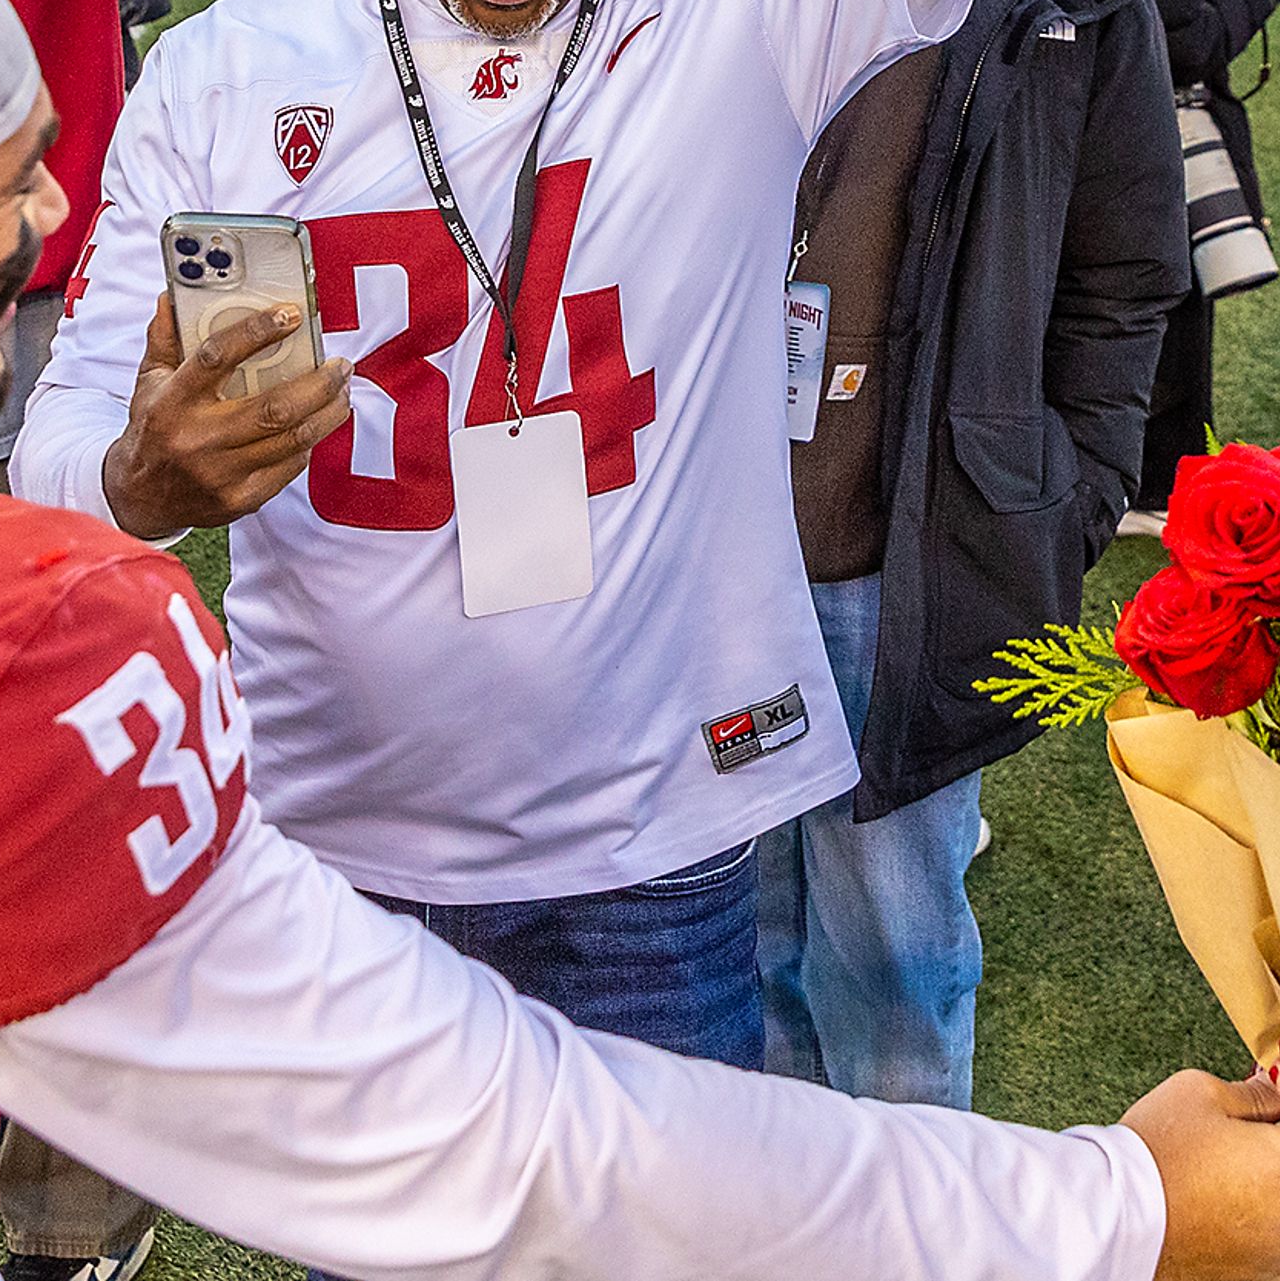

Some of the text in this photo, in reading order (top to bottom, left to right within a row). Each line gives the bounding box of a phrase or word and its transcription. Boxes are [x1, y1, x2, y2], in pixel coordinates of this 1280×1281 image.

[277, 109, 328, 157] PAC
[289, 144, 313, 170] 12
[788, 299, 824, 331] NIGHT
[305, 158, 657, 533] 34
[764, 702, 795, 727] XL
[56, 592, 253, 897] 34
[718, 732, 752, 751] TEAM
